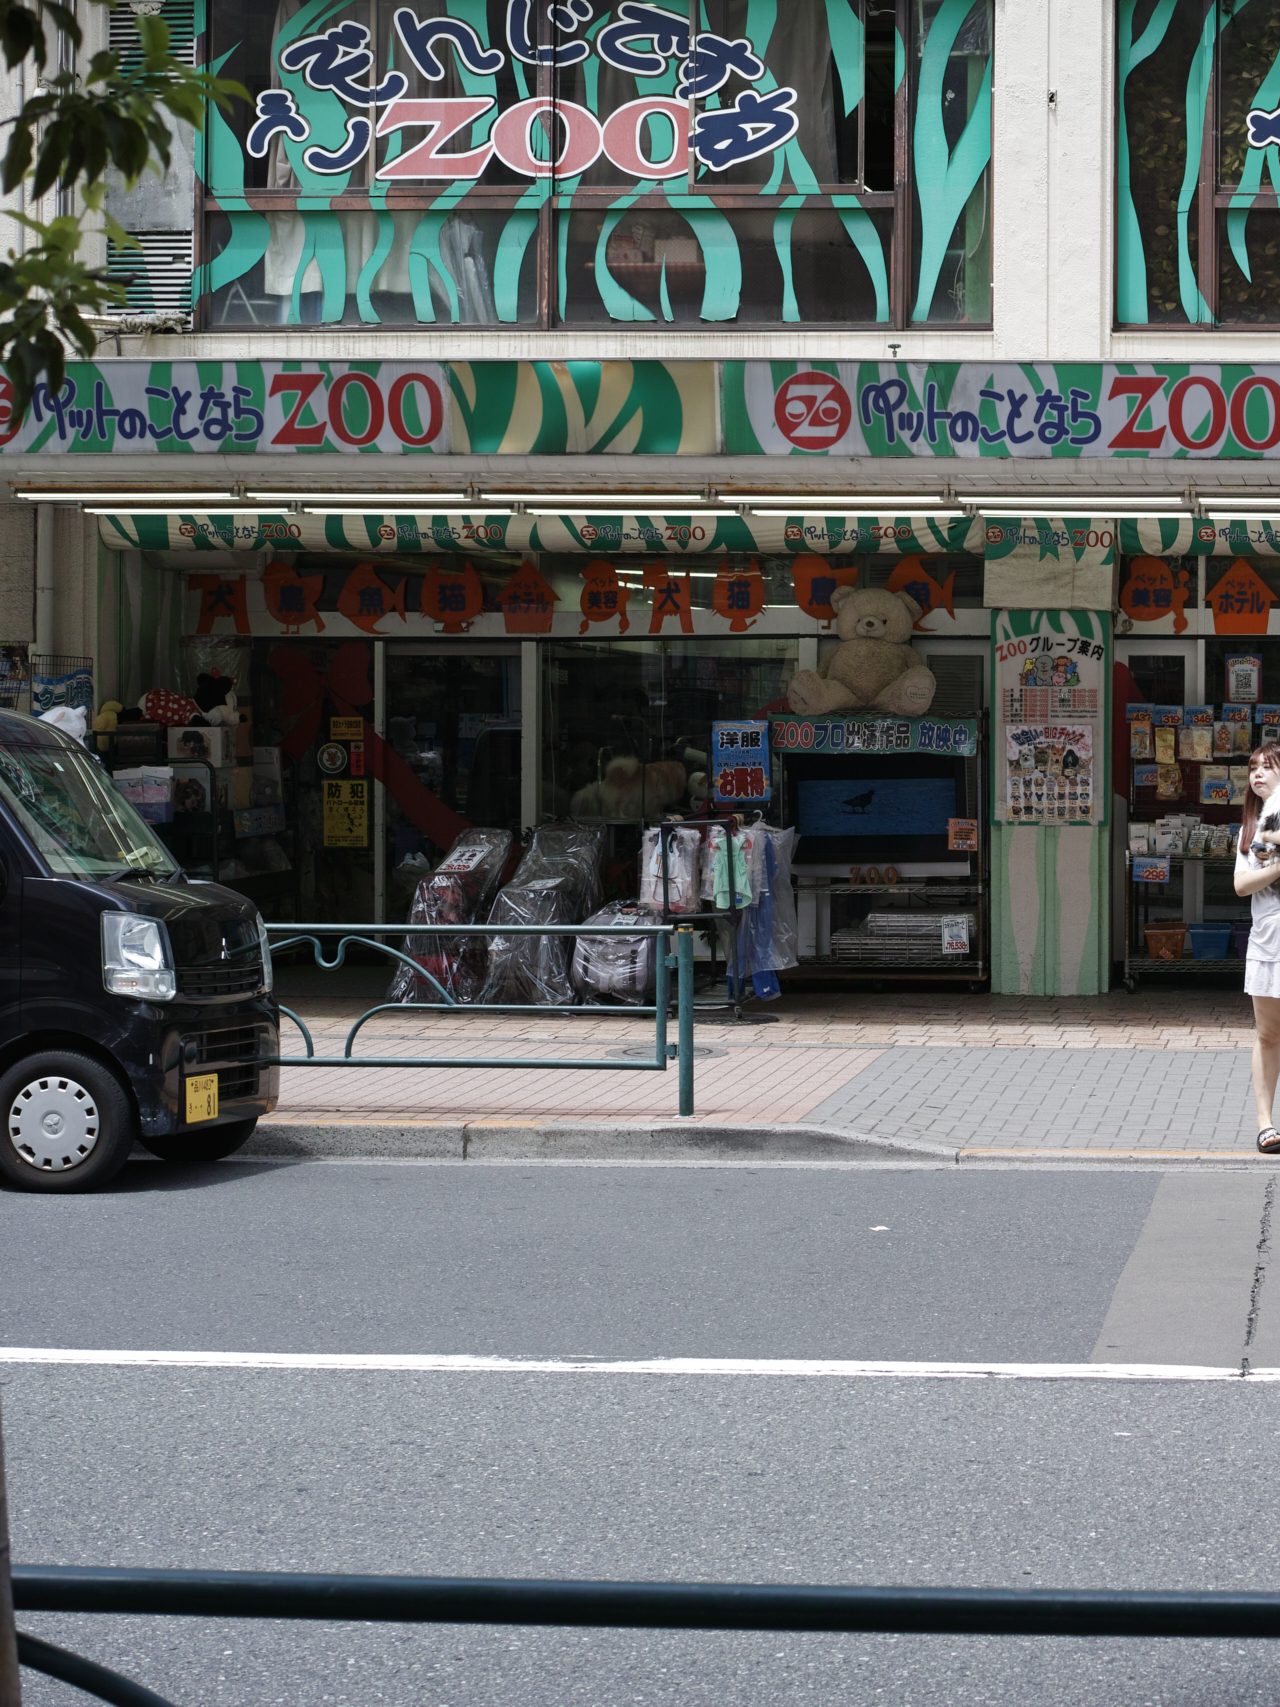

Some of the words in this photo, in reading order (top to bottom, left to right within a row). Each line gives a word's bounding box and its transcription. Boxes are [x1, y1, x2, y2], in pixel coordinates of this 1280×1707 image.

[375, 97, 689, 180] ZOO
[33, 377, 264, 441] ペットのことなら
[268, 373, 444, 447] ZOO
[861, 378, 1101, 445] ペットのことなら
[197, 523, 260, 540] ペットのことなら
[260, 523, 302, 540] ZOO
[397, 524, 460, 541] ペットのことなら
[462, 524, 504, 540] ZOO
[600, 525, 663, 542] ペットのことなら
[665, 525, 706, 541] ZOO
[804, 526, 868, 542] ペットのことなら
[869, 525, 911, 540] ZOO
[1006, 526, 1070, 547] ペットのことなら
[1072, 530, 1113, 548] ZOO
[515, 581, 540, 592] ペット
[590, 577, 614, 587] ペット
[1135, 574, 1168, 587] ペット
[1225, 579, 1256, 589] ペット
[208, 585, 234, 611] 犬
[280, 587, 305, 613] 鳥
[358, 587, 384, 614] 魚
[438, 585, 466, 612] 猫
[508, 592, 548, 613] ホテル
[588, 590, 617, 610] 美容
[657, 582, 681, 612] 犬
[727, 580, 750, 611] 猫
[811, 578, 836, 606] 鳥
[1131, 588, 1172, 609] 美容
[1218, 592, 1265, 614] ホテル
[719, 730, 763, 749] 洋服
[917, 720, 970, 752] 放映中
[850, 866, 899, 885] ZOO
